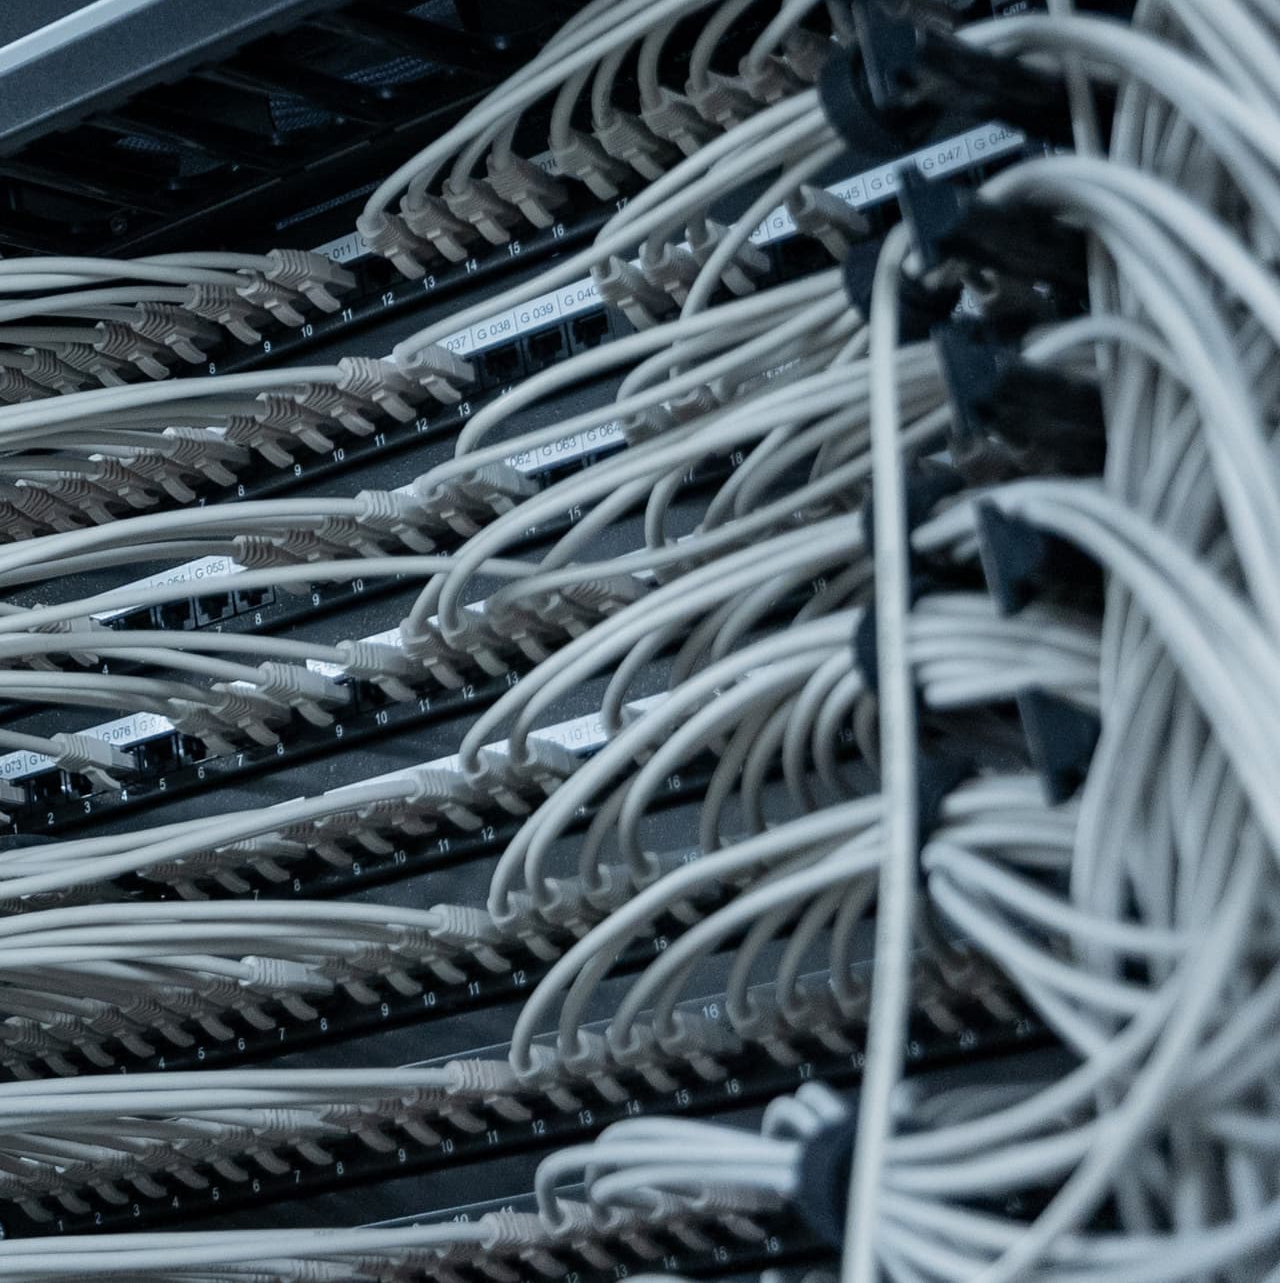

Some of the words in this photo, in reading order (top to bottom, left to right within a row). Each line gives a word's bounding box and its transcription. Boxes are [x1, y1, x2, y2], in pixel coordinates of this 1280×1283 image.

[974, 136, 986, 151] G
[209, 362, 217, 375] 8
[263, 340, 271, 353] 9
[301, 324, 314, 338] 10
[342, 309, 353, 322] 11
[382, 291, 395, 306] 12
[423, 275, 436, 290] 13
[465, 259, 478, 274] 14
[507, 241, 521, 256] 15
[551, 224, 565, 239] 16
[332, 241, 351, 259] 011
[477, 326, 487, 341] G
[489, 319, 512, 336] 038
[520, 310, 530, 325] G
[532, 302, 554, 320] 039
[564, 293, 574, 307] G
[576, 285, 598, 303] 040
[871, 177, 882, 192] G
[923, 156, 934, 172] G
[937, 146, 961, 166] 047
[195, 565, 205, 580] G
[206, 559, 226, 576] 055
[543, 442, 553, 457] G
[554, 436, 578, 454] 063
[586, 427, 597, 442] G
[238, 484, 245, 497] 8
[294, 463, 302, 478] 9
[332, 448, 345, 462] 10
[374, 434, 385, 448] 11
[415, 418, 428, 432] 12
[457, 402, 471, 417] 13
[216, 625, 223, 637] 7
[255, 612, 262, 626] 8
[313, 593, 320, 607] 9
[351, 579, 364, 594] 10
[568, 505, 582, 521] 15
[730, 451, 744, 468] 18
[5, 758, 23, 773] 073
[28, 752, 38, 766] G
[101, 729, 112, 743] G
[112, 723, 131, 739] 076
[13, 823, 18, 835] 1
[47, 812, 55, 825] 2
[83, 800, 91, 814] 3
[121, 789, 128, 802] 4
[159, 778, 166, 791] 5
[197, 766, 205, 779] 6
[236, 754, 244, 767] 7
[276, 743, 285, 755] 8
[336, 724, 343, 738] 9
[376, 711, 388, 726] 10
[419, 699, 431, 712] 11
[462, 685, 475, 700] 12
[505, 672, 520, 687] 13
[293, 878, 301, 892] 8
[352, 862, 361, 876] 9
[393, 850, 407, 865] 10
[438, 839, 450, 854] 11
[481, 826, 495, 841] 12
[667, 774, 681, 790] 16
[157, 1055, 166, 1069] 4
[198, 1047, 206, 1060] 5
[238, 1037, 246, 1051] 6
[278, 1027, 286, 1040] 7
[320, 1017, 328, 1031] 8
[381, 1003, 389, 1017] 9
[423, 992, 436, 1006] 10
[468, 981, 480, 995] 11
[512, 970, 526, 985] 12
[653, 936, 668, 951] 15
[702, 1002, 720, 1019] 16
[57, 1219, 64, 1232] 1
[95, 1212, 103, 1225] 2
[133, 1204, 141, 1217] 3
[171, 1196, 180, 1208] 4
[212, 1187, 220, 1200] 5
[252, 1180, 261, 1193] 6
[295, 1169, 302, 1183] 7
[336, 1161, 345, 1175] 8
[398, 1148, 407, 1163] 9
[441, 1139, 454, 1153] 10
[486, 1129, 499, 1144] 11
[531, 1119, 546, 1135] 12
[578, 1110, 594, 1125] 13
[626, 1099, 641, 1114] 14
[674, 1089, 689, 1105] 15
[724, 1079, 740, 1095] 16
[797, 1063, 813, 1079] 17
[850, 1052, 866, 1068] 18
[614, 1264, 629, 1280] 13
[663, 1254, 678, 1270] 14
[712, 1246, 728, 1262] 15
[763, 1237, 779, 1253] 16
